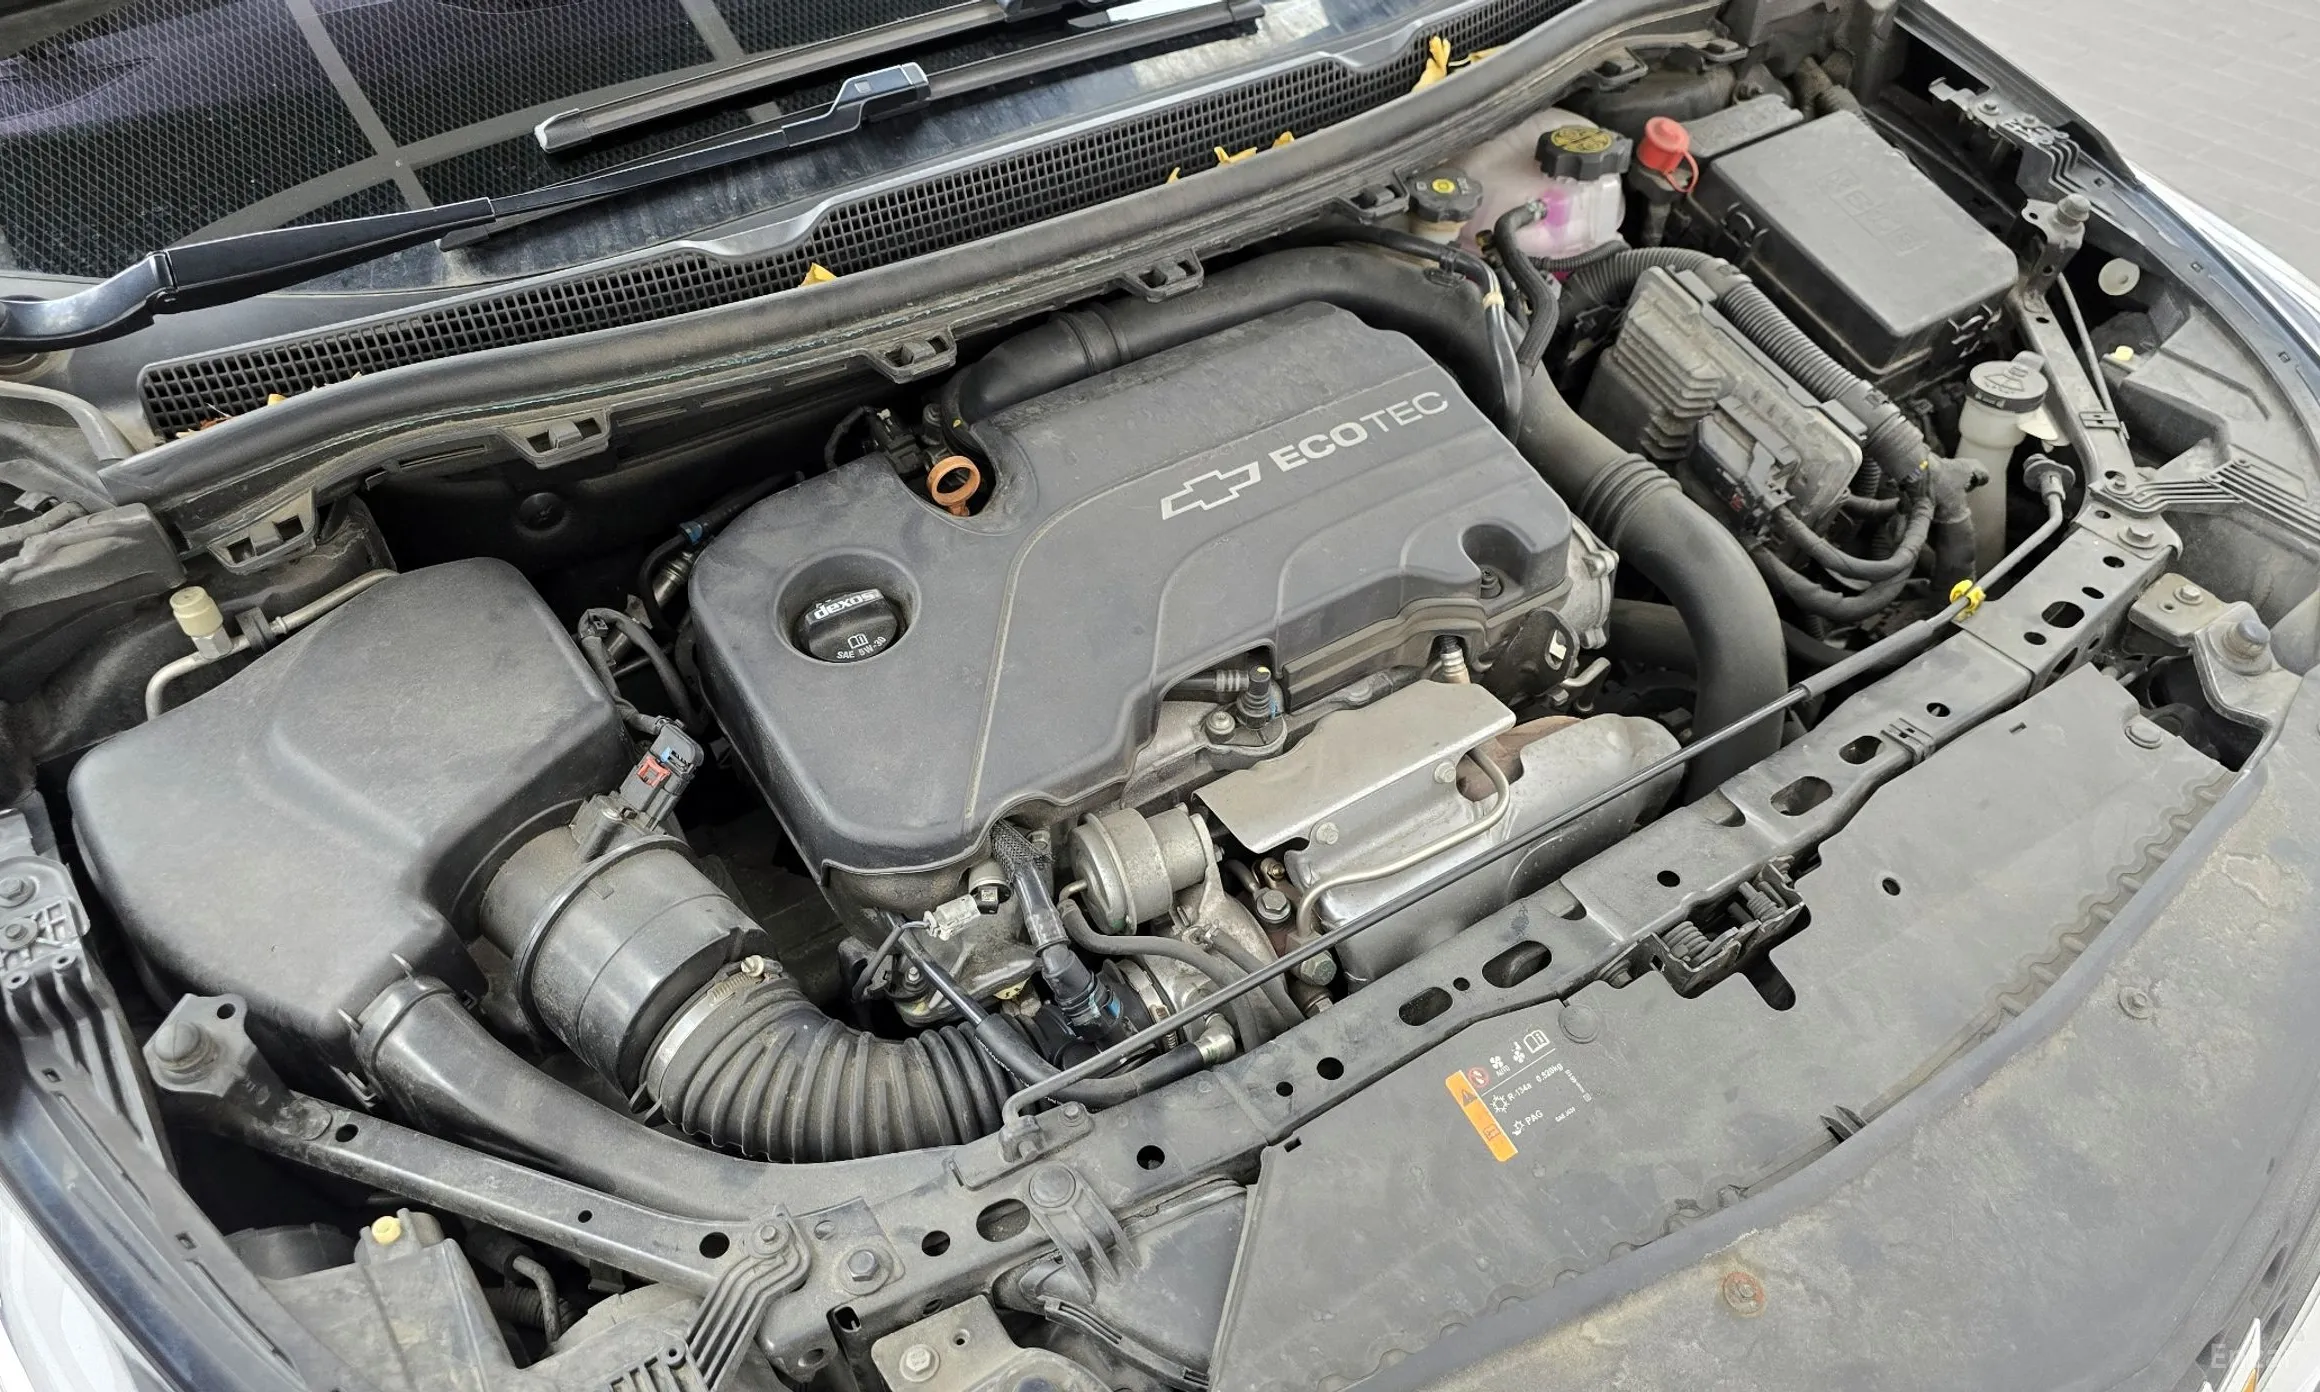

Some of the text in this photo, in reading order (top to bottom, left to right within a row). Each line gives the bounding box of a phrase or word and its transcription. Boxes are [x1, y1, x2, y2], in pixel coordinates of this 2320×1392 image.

[1268, 391, 1449, 472] ECOTEC
[837, 651, 855, 659] SAE
[1524, 1110, 1544, 1126] PAG
